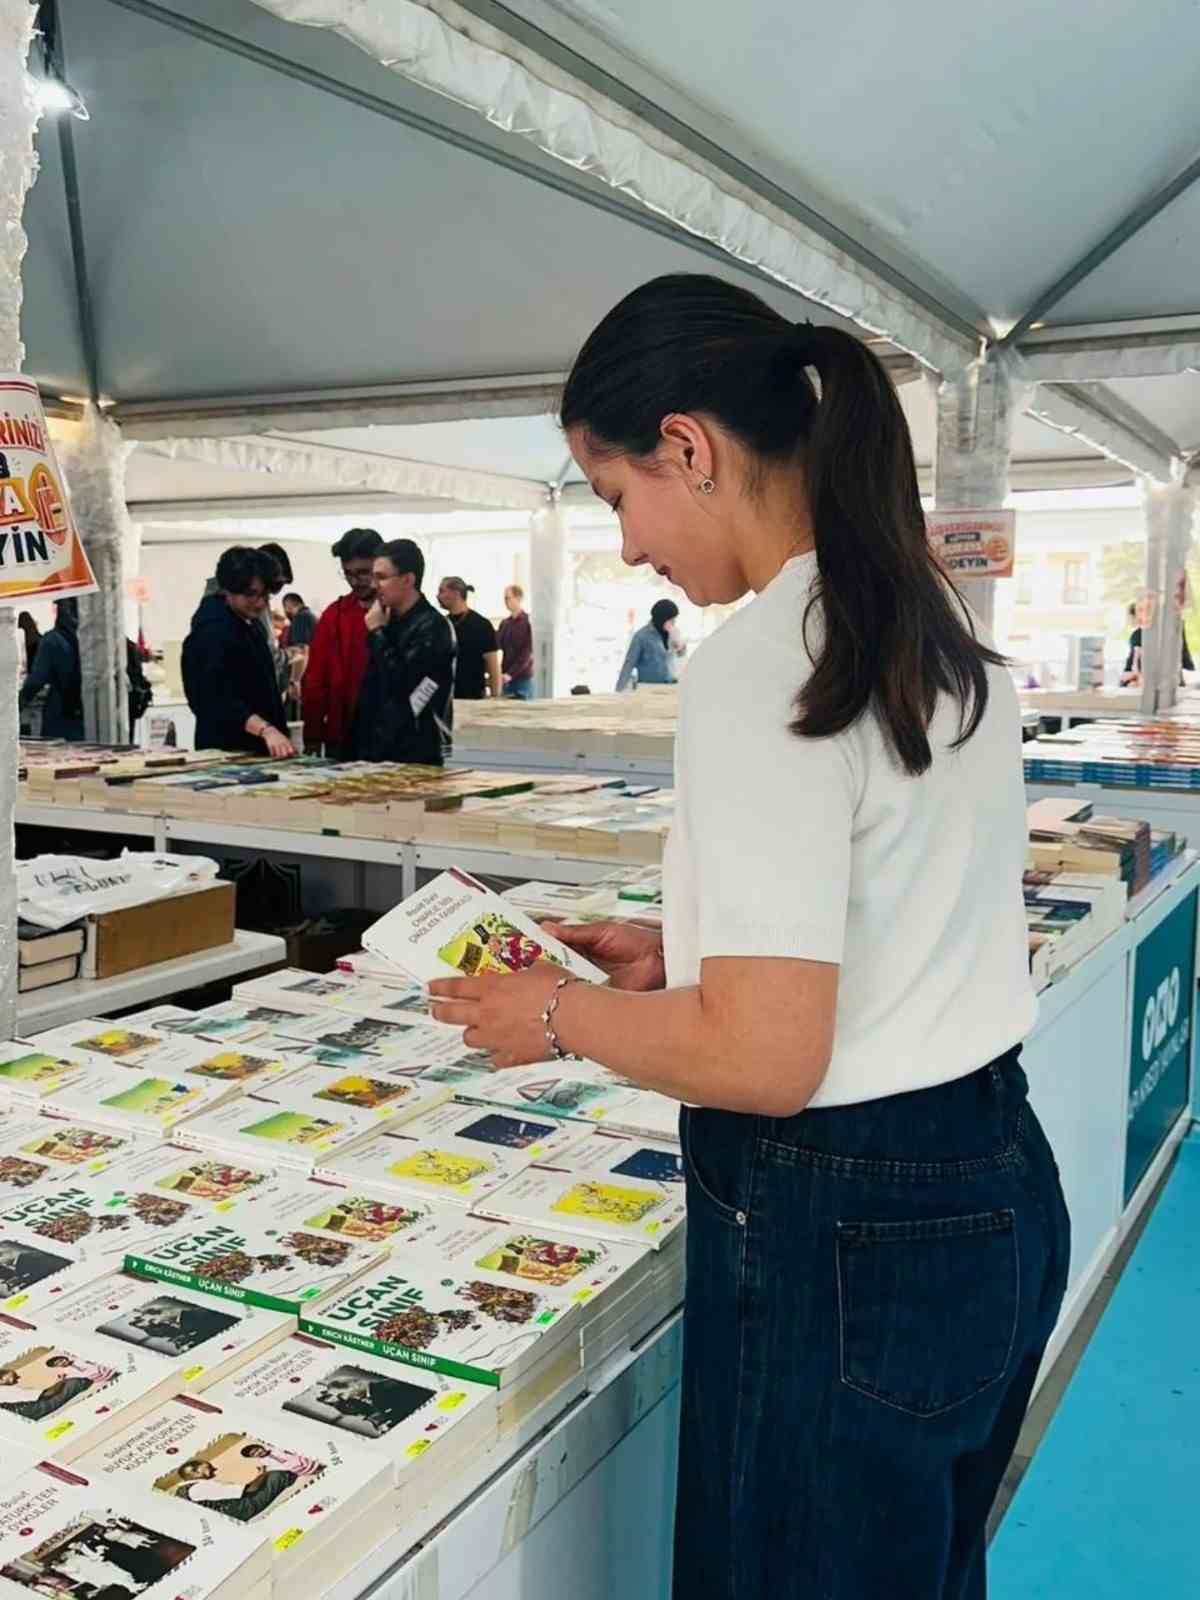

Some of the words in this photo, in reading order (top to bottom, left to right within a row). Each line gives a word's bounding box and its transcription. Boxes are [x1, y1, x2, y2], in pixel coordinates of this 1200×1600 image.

[2, 1187, 85, 1221] UÇAN
[24, 1197, 94, 1231] SINIF
[152, 1226, 234, 1260] UÇAN
[179, 1236, 246, 1269] SINIF
[198, 1279, 222, 1292] UÇAN
[327, 1275, 408, 1321] UÇAN
[358, 1288, 423, 1330] SINIF
